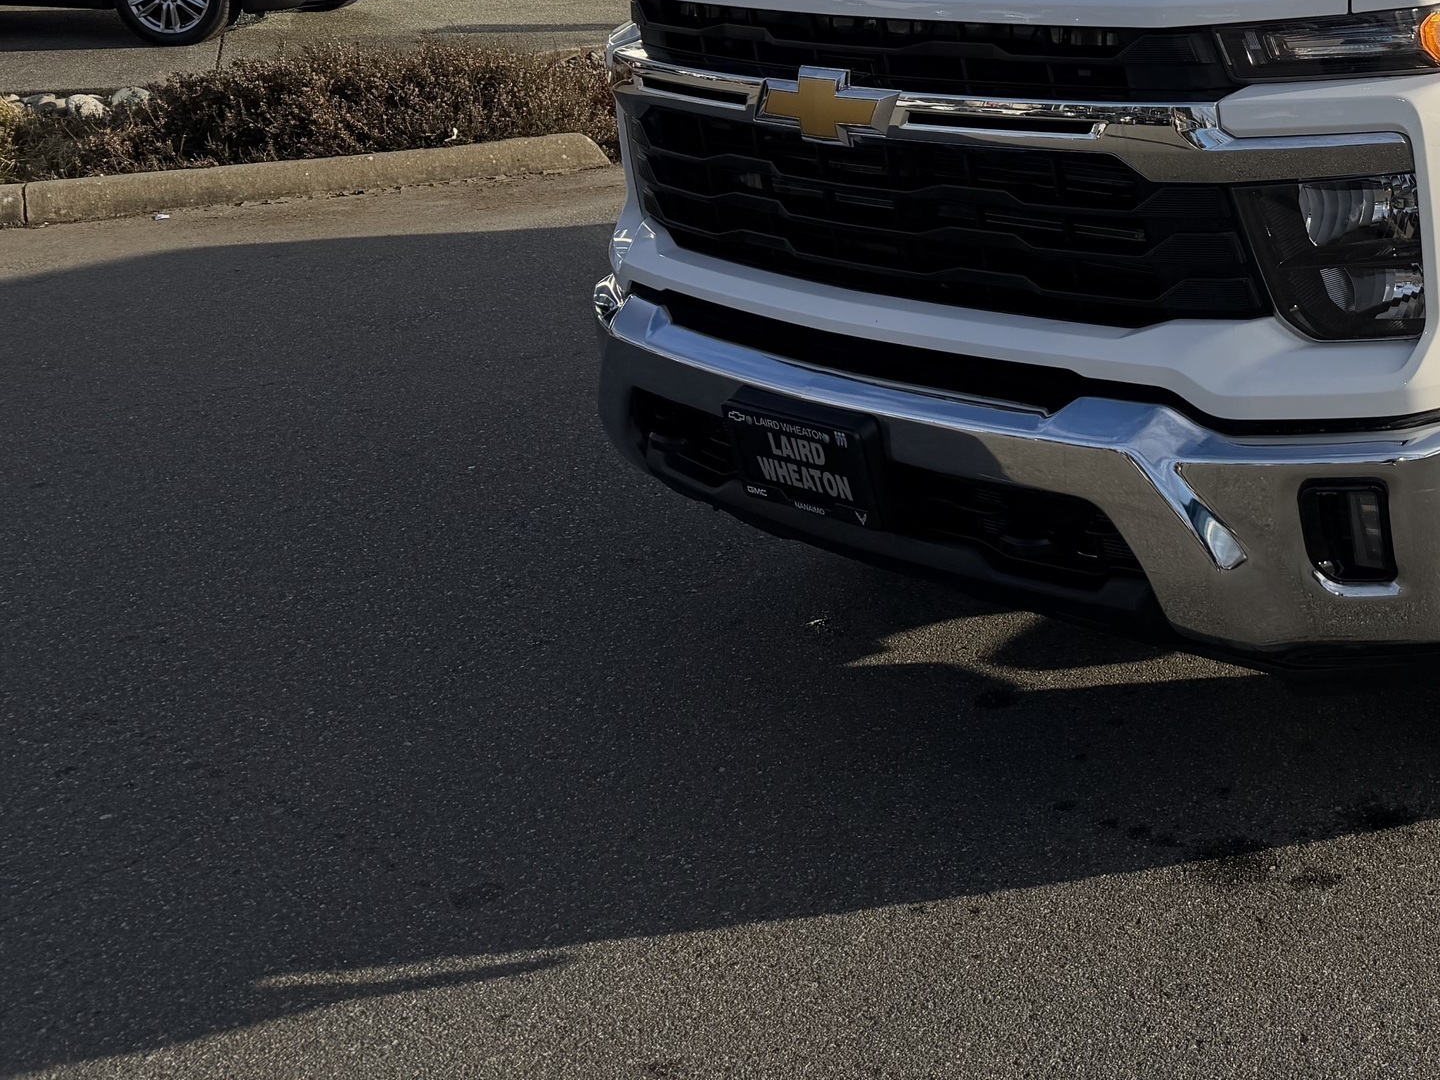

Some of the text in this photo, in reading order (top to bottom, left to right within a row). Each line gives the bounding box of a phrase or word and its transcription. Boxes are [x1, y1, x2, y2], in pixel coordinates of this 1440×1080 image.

[753, 416, 826, 440] LAIRD WHEATON
[767, 432, 826, 466] LAIRD
[756, 455, 853, 502] WHEATON
[747, 485, 768, 497] GMC
[794, 501, 826, 516] NANAIMO
